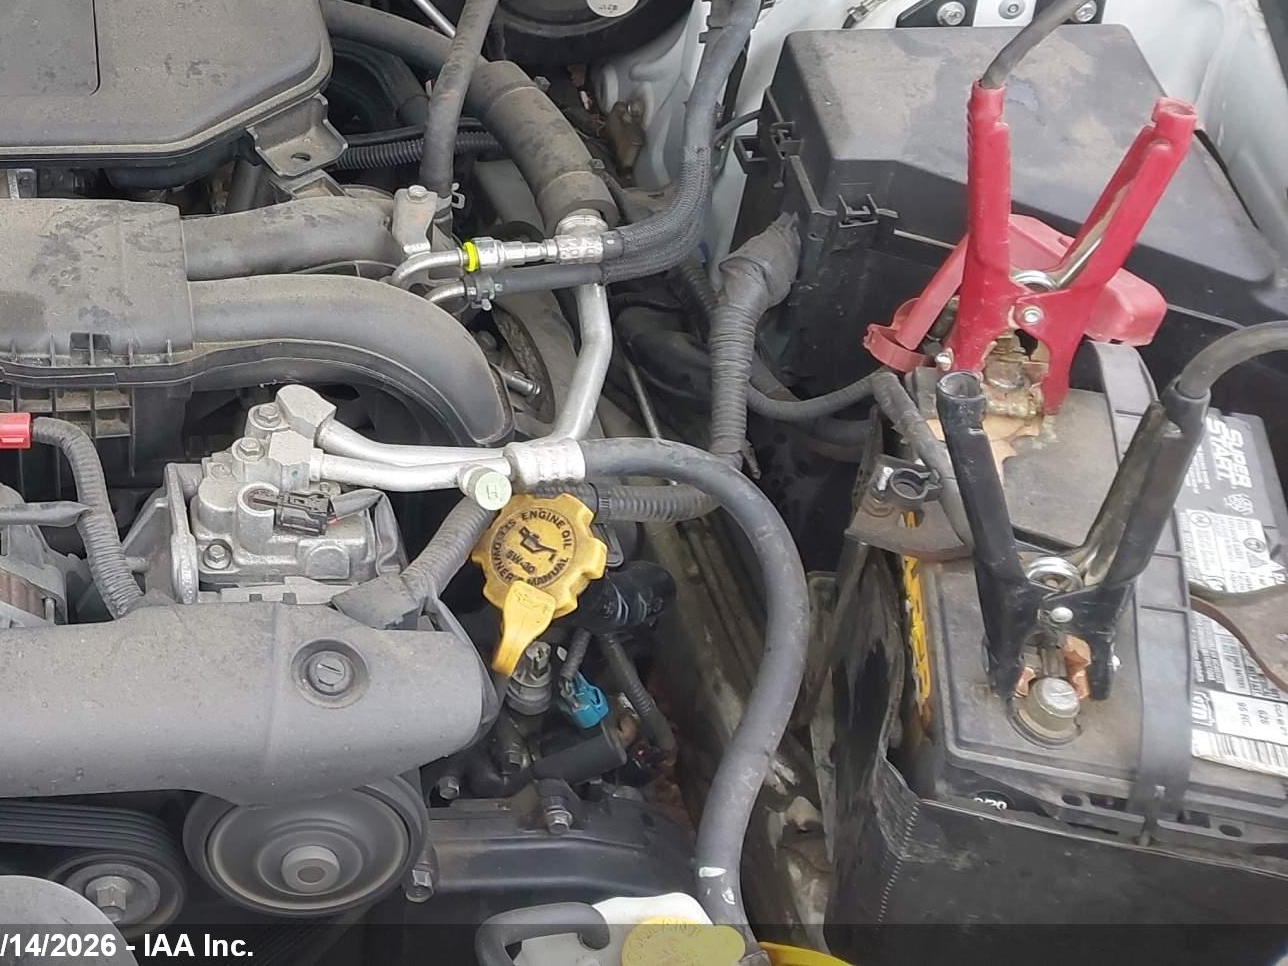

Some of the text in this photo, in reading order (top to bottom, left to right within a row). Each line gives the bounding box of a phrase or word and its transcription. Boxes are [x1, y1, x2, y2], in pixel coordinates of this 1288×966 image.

[1206, 416, 1232, 481] START
[1230, 428, 1252, 489] SUPER
[521, 510, 573, 550] ENGINE OIL
[526, 557, 569, 587] MANUAL
